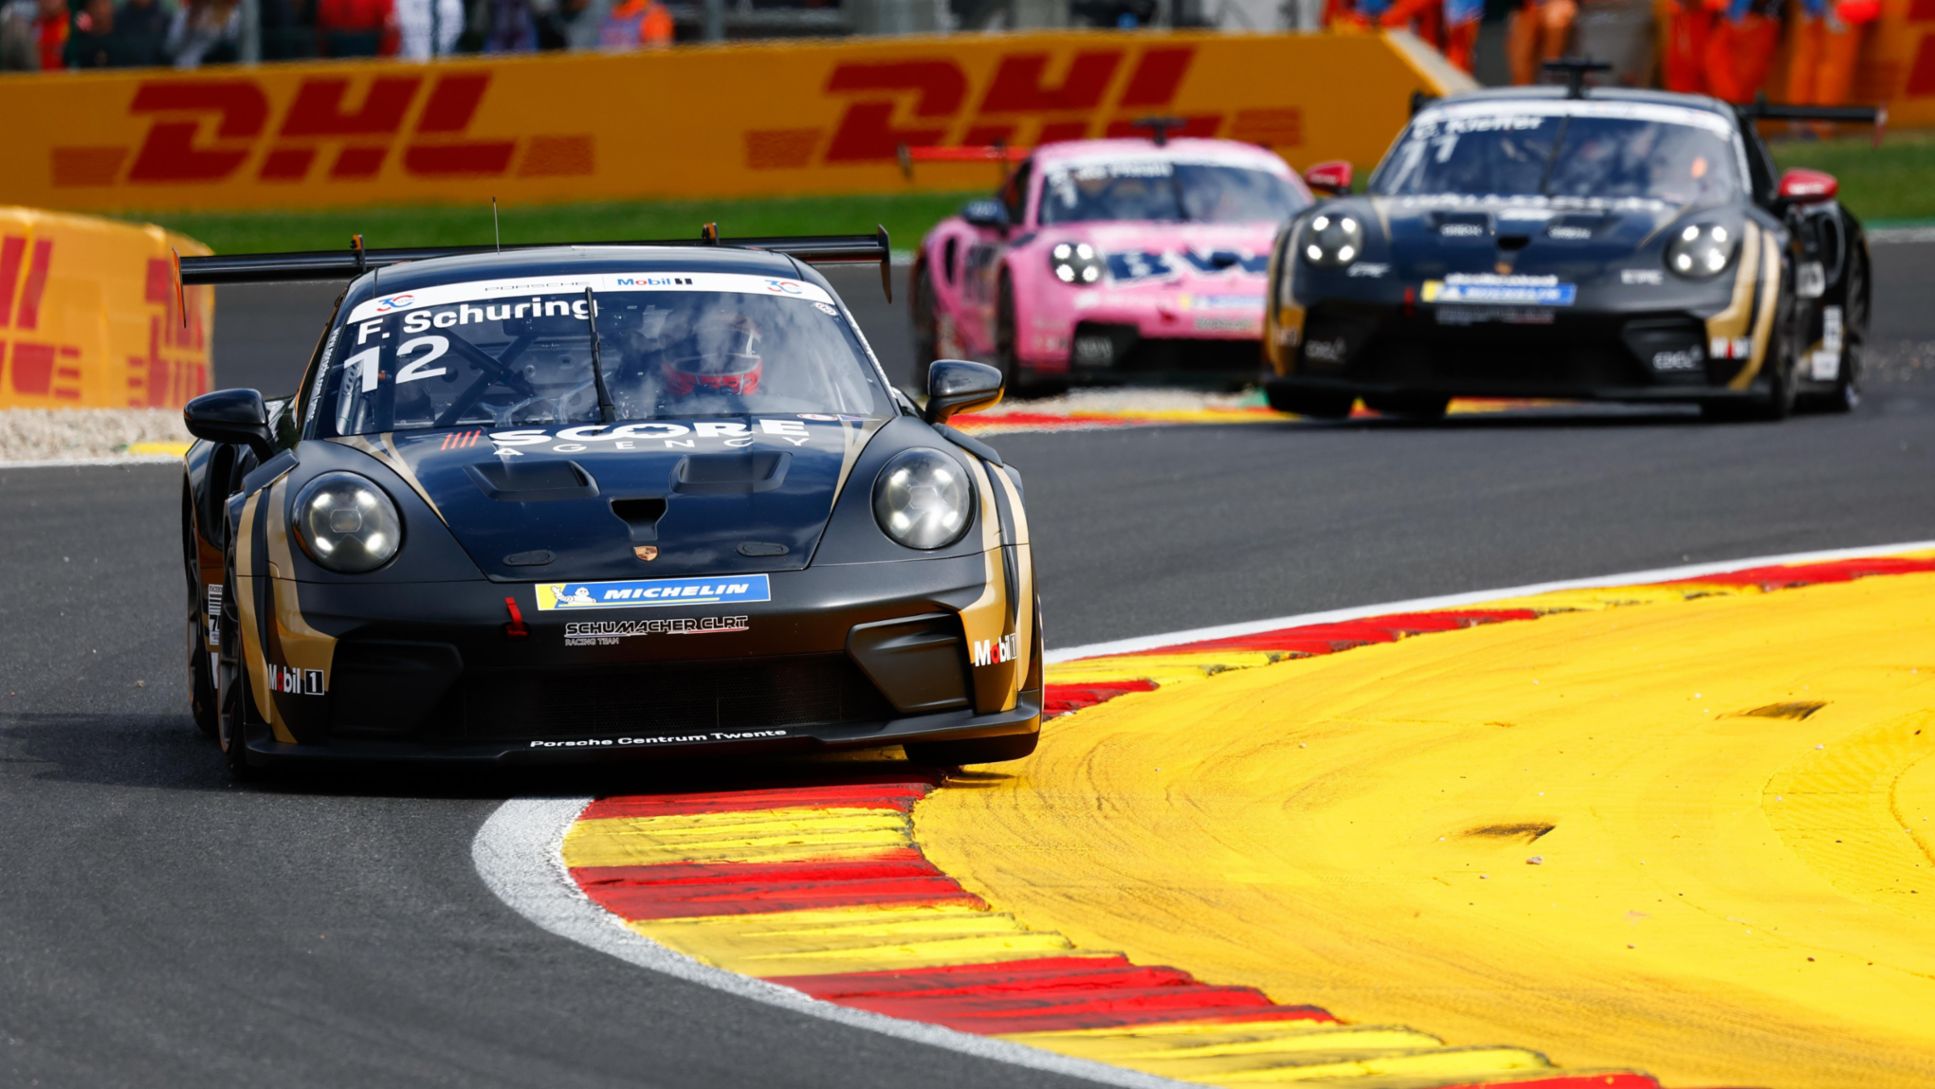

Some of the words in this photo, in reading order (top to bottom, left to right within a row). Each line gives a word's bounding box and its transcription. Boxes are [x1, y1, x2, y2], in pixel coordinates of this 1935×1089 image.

[825, 48, 1222, 162] DHL
[128, 73, 516, 182] DHL
[617, 278, 671, 286] Mobil
[358, 318, 391, 345] F.
[403, 297, 598, 334] Schuring
[344, 336, 449, 393] 12
[488, 418, 811, 447] SCORE
[493, 436, 810, 457] AGENCY
[603, 583, 749, 600] MICHELIN
[565, 619, 699, 635] SCHUMACHER
[701, 616, 749, 631] CLRT
[565, 637, 596, 646] RACING
[598, 637, 619, 645] TEAM
[975, 635, 1009, 667] Mobil
[268, 664, 300, 693] Mobil
[304, 669, 325, 695] 1
[530, 738, 612, 748] Porsche
[617, 734, 708, 745] Centrum
[710, 729, 787, 740] Twente
